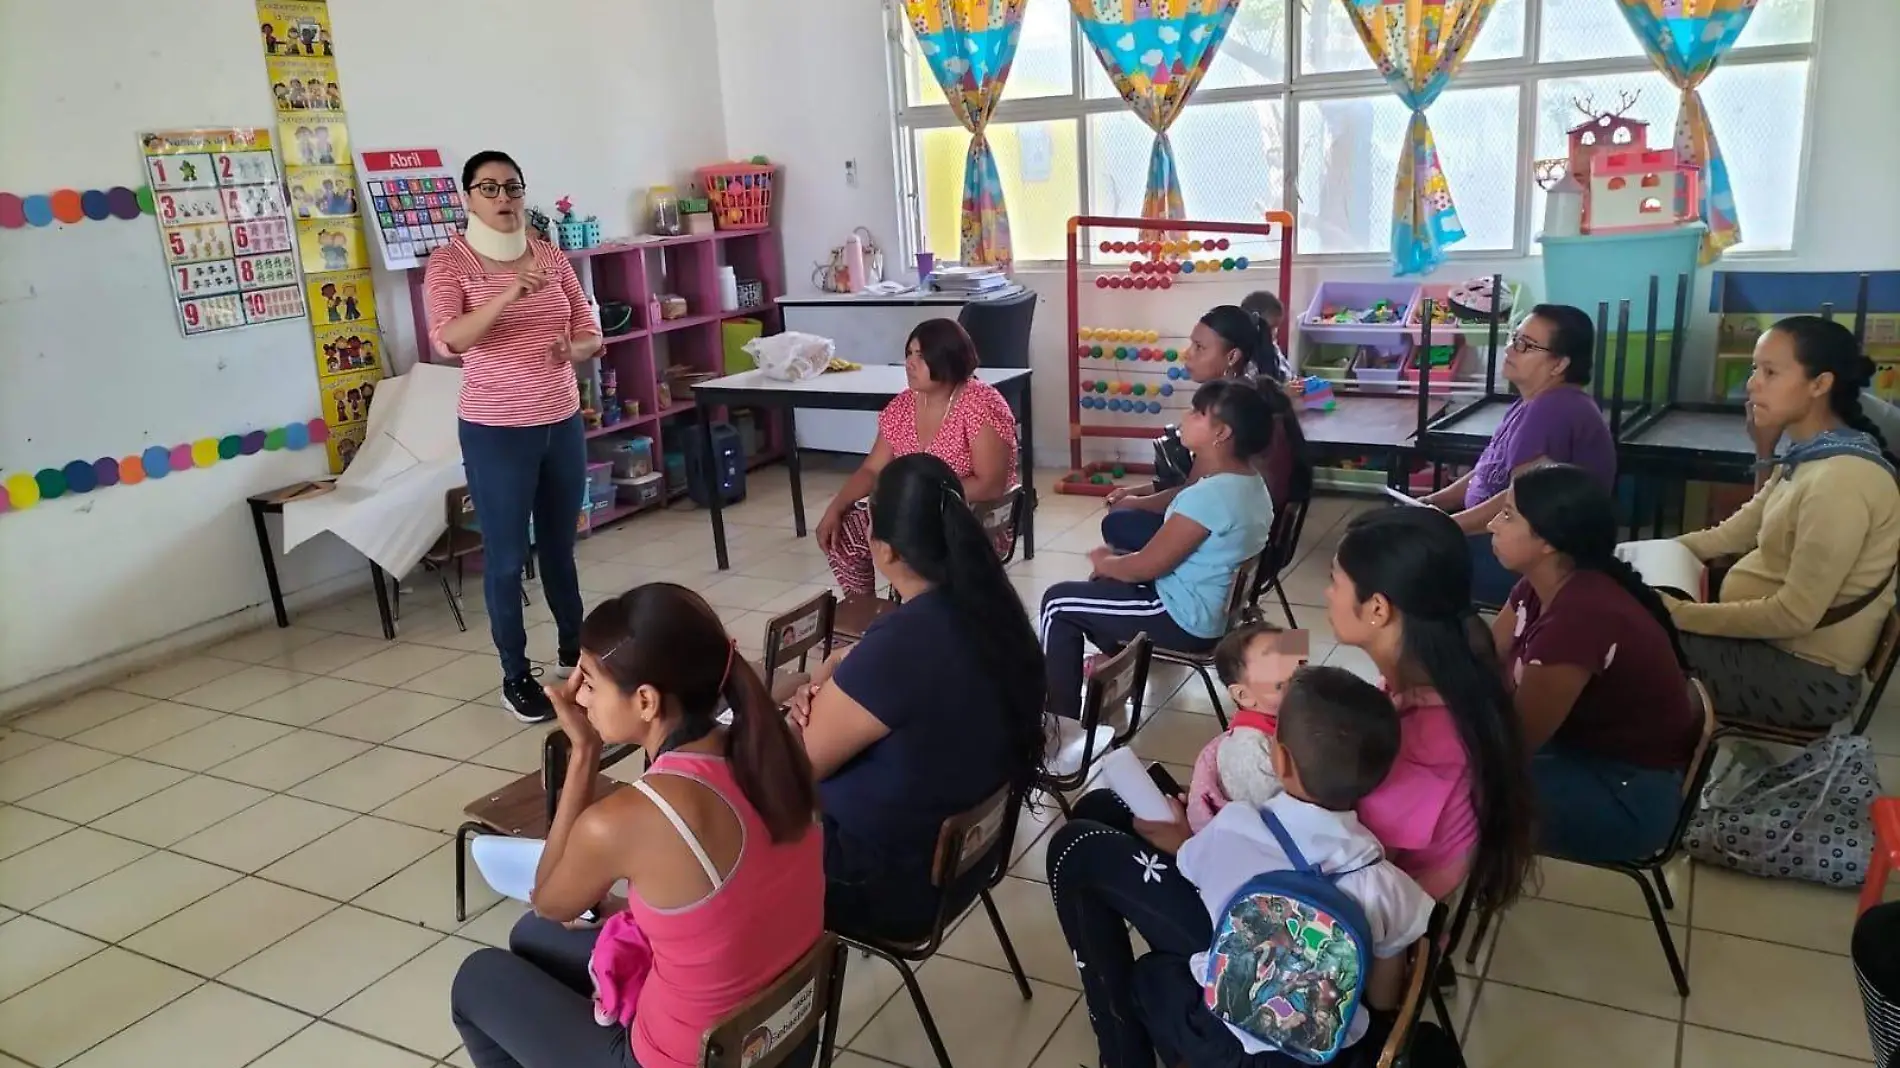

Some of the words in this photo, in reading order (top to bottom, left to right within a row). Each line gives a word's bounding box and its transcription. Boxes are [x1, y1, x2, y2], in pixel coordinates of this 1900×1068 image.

[153, 160, 166, 182] 1
[219, 155, 233, 178] 2
[389, 152, 422, 168] Abril
[160, 195, 176, 219] 3
[169, 231, 185, 255] 5
[235, 225, 248, 248] 6
[177, 267, 189, 291] 7
[241, 260, 254, 282] 8
[184, 303, 199, 326] 9
[246, 293, 266, 317] 10
